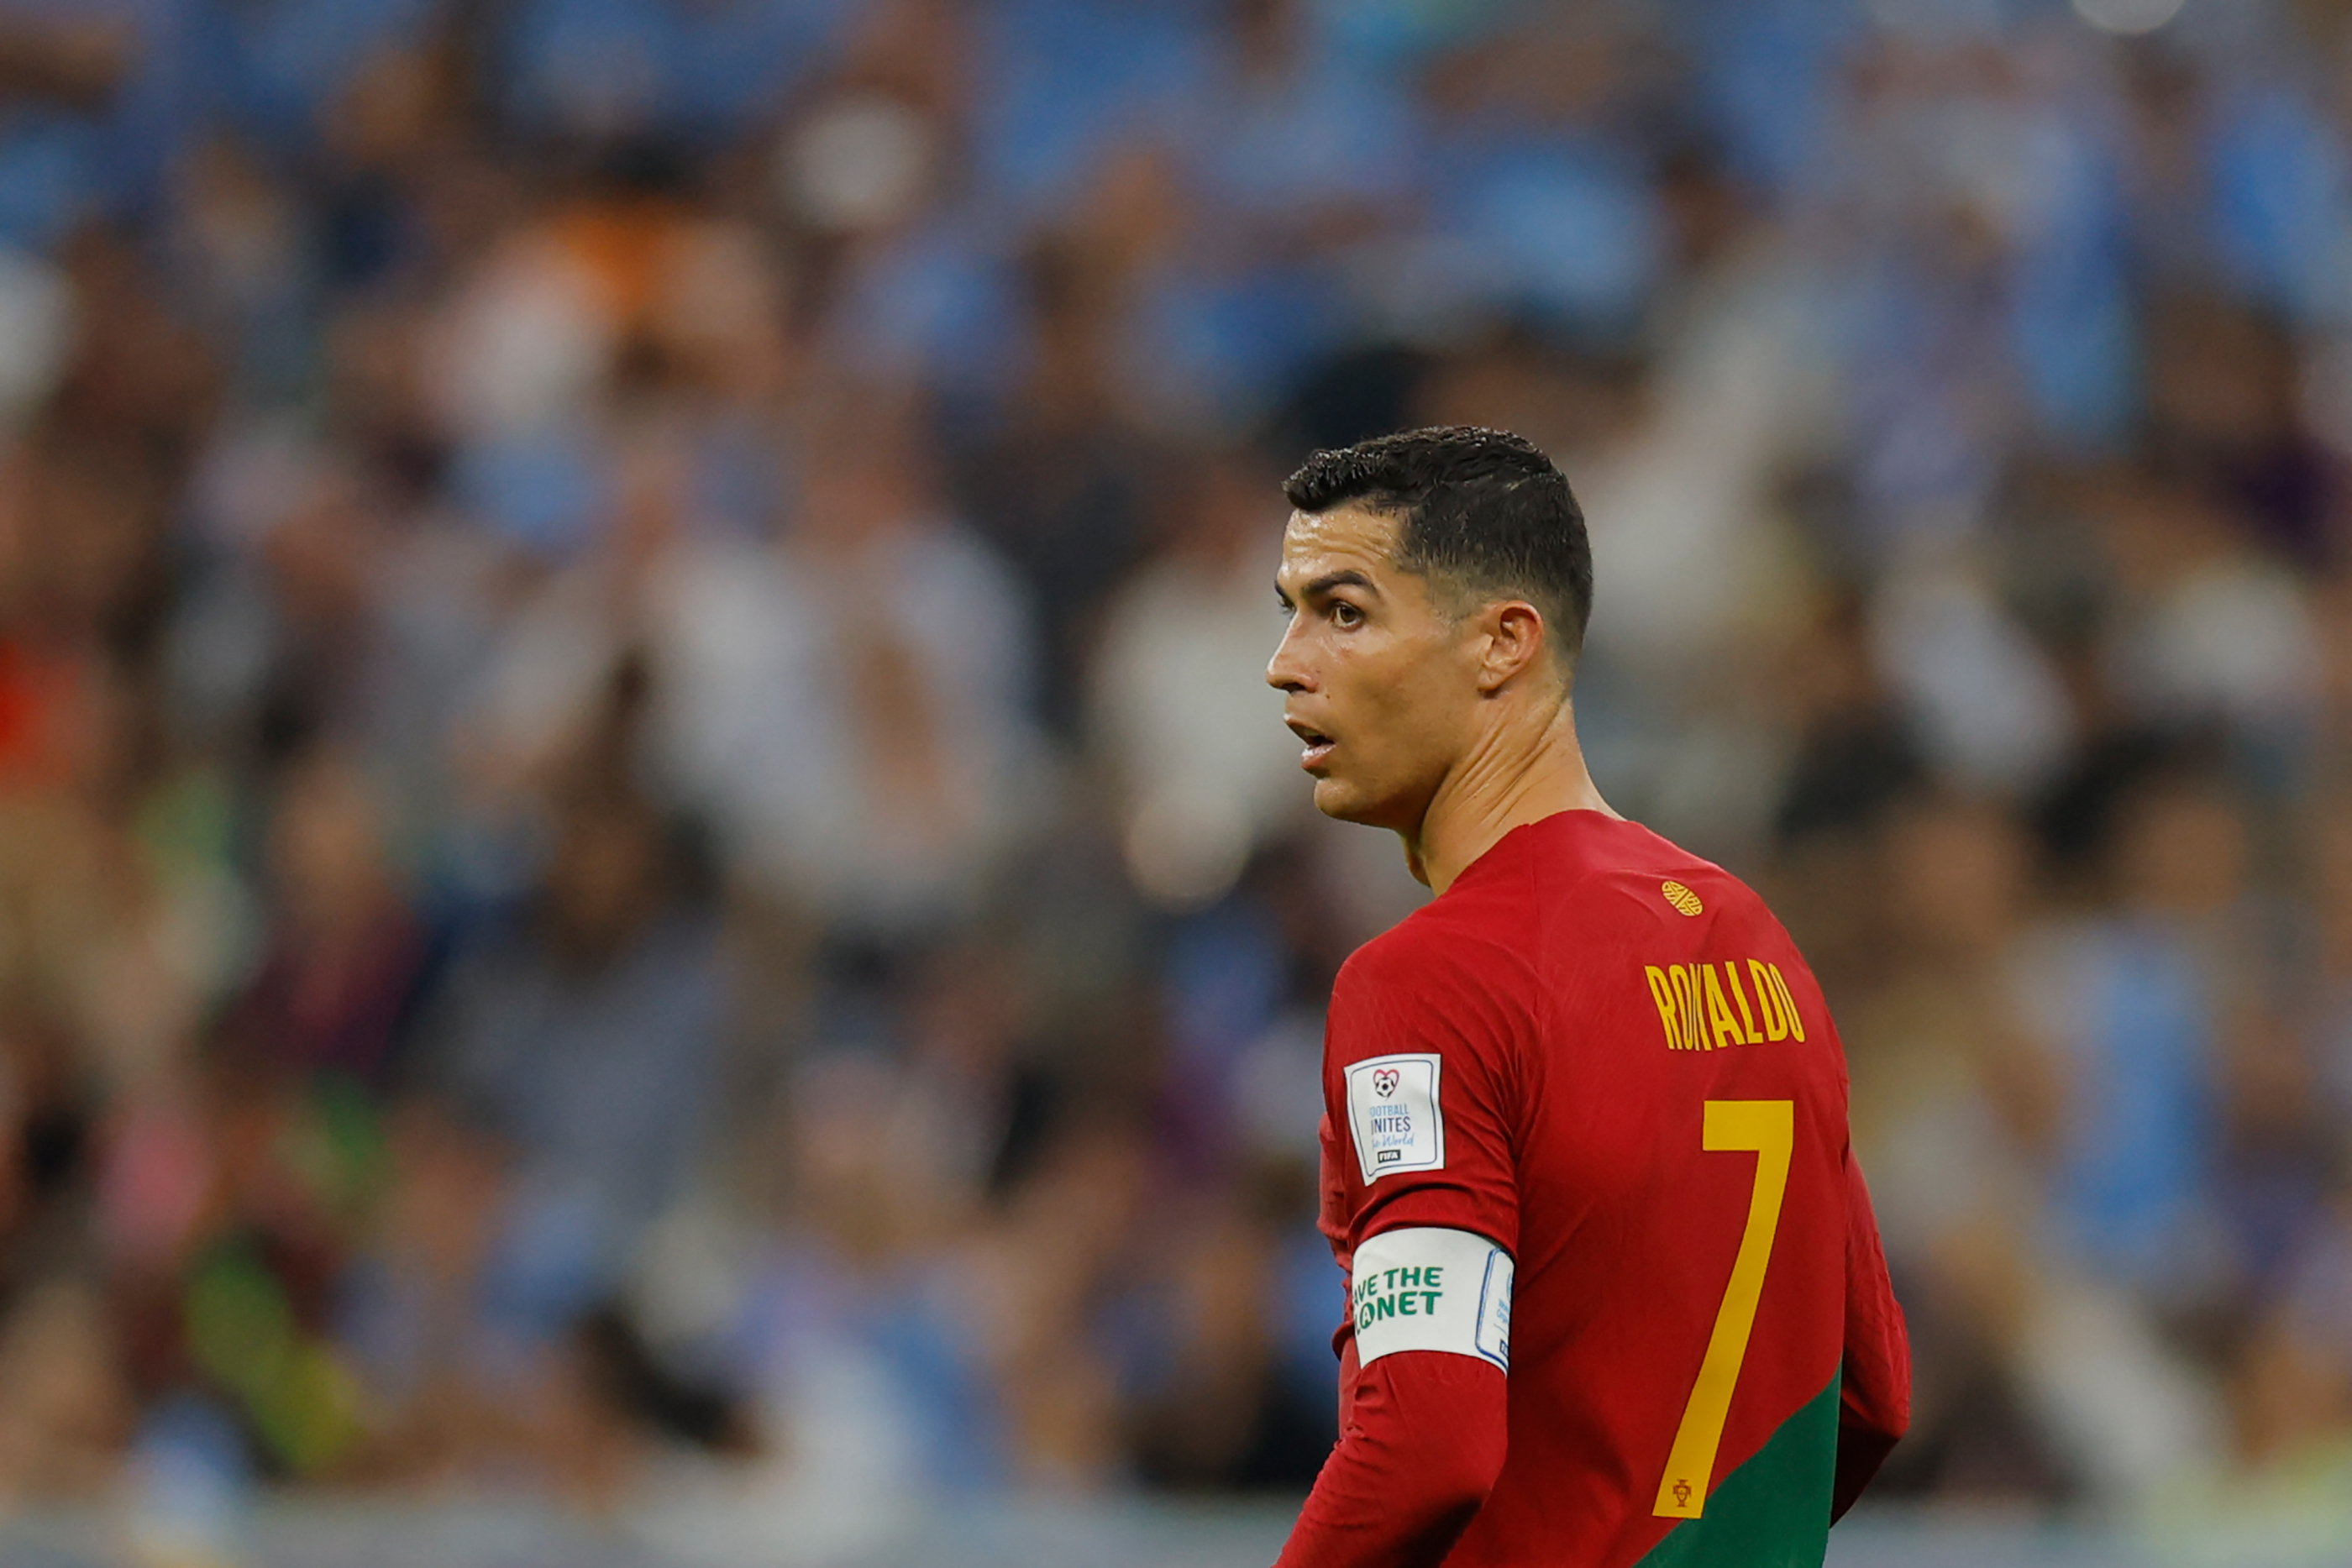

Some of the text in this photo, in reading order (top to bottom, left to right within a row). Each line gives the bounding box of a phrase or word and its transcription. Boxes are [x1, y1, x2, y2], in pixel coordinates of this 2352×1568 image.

[1645, 958, 1806, 1051] RONALDO
[1369, 1104, 1410, 1117] OOTBALL
[1379, 1151, 1399, 1162] FIFA
[1382, 1132, 1415, 1147] World
[1354, 1266, 1444, 1306] AVE THE
[1355, 1291, 1443, 1335] LANET
[1652, 1100, 1794, 1519] 7
